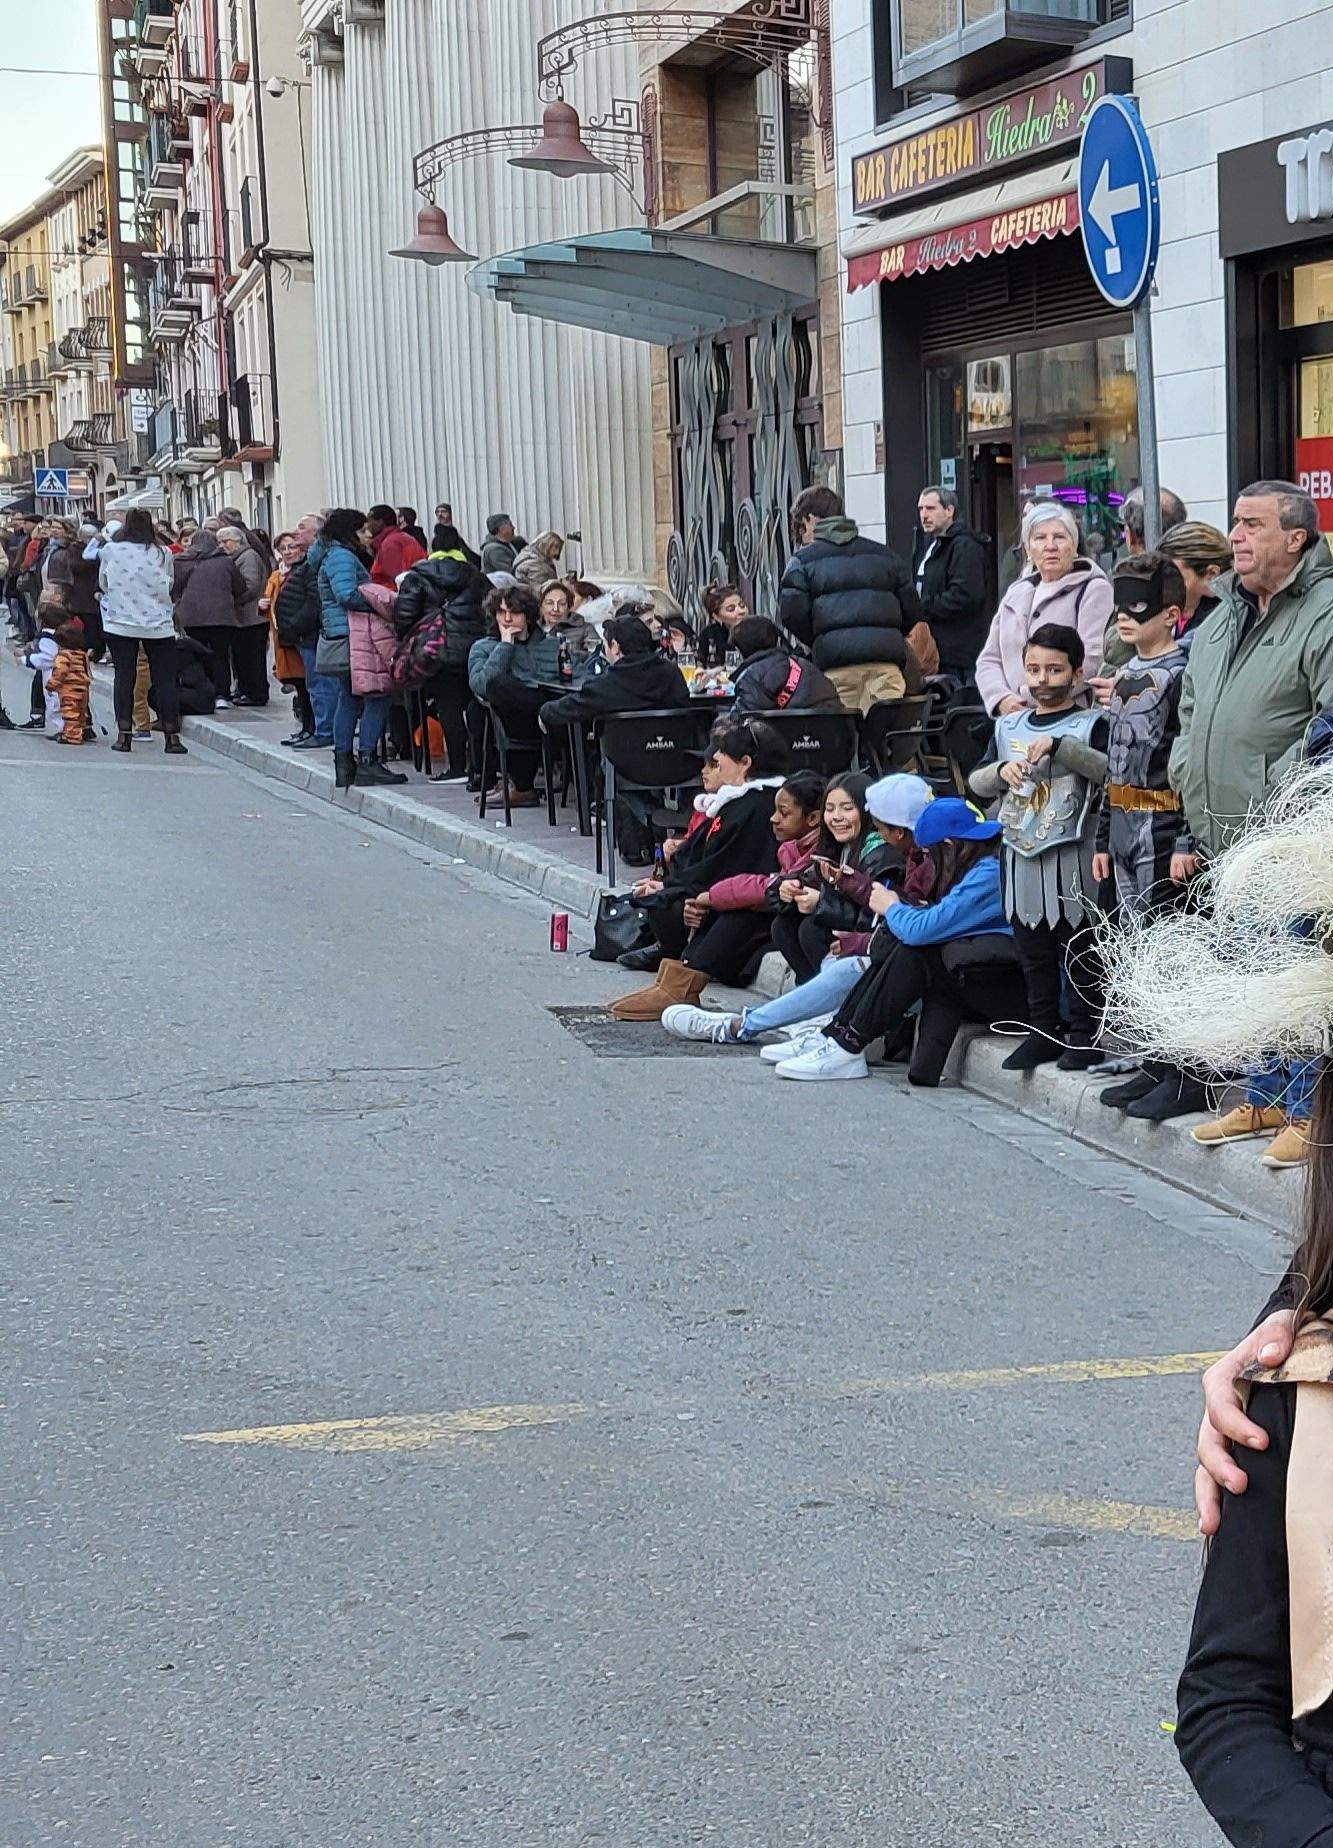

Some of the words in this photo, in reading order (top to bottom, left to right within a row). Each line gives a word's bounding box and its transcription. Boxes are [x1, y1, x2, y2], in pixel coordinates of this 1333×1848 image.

[856, 157, 886, 204] BAR
[890, 118, 974, 193] CAFETERIA
[984, 95, 1053, 163] Hiedra
[879, 245, 904, 275] BAR
[917, 230, 965, 264] Hiedra
[967, 228, 977, 251] 2
[990, 197, 1067, 246] CAFETERIA
